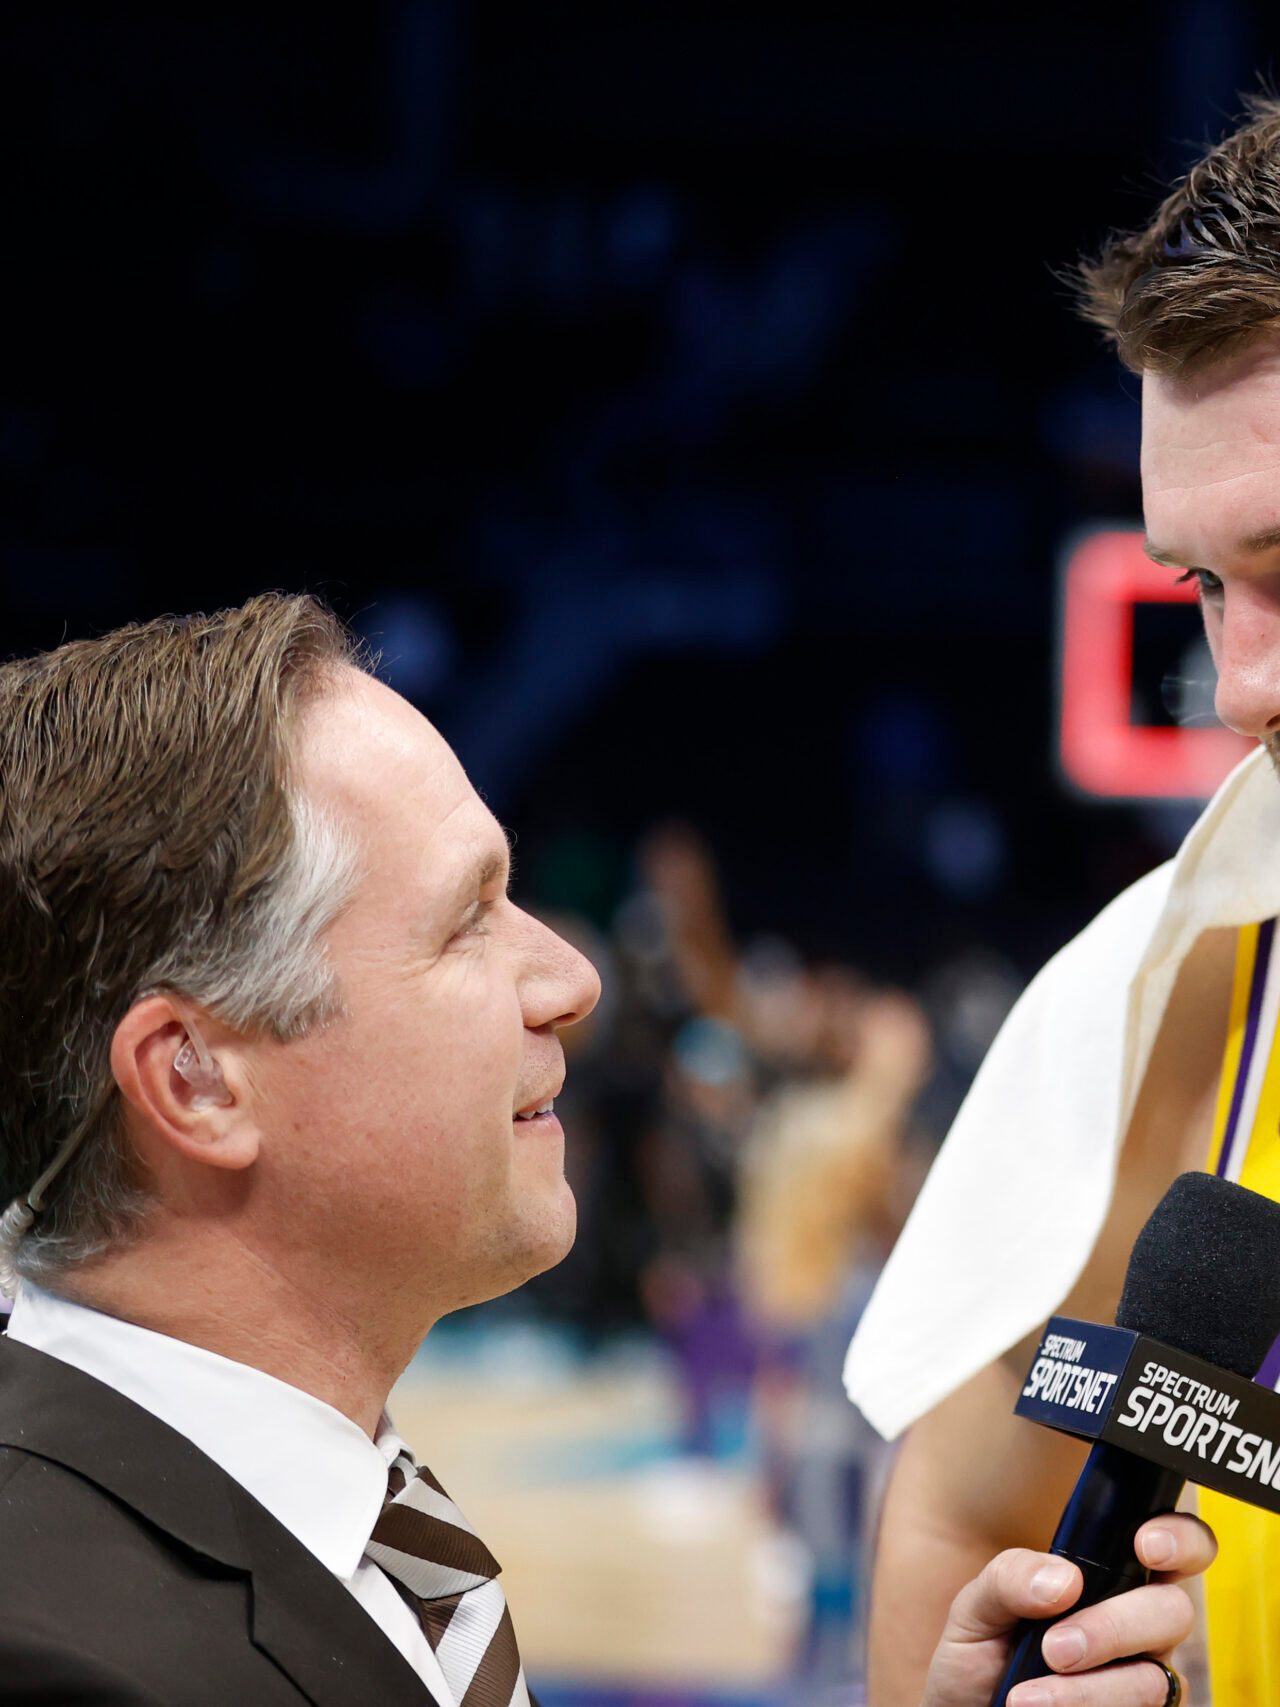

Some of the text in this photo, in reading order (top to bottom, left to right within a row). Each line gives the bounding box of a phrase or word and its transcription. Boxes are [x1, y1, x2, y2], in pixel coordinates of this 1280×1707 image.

[1040, 1334, 1087, 1363] SPECTRUM
[1022, 1358, 1118, 1415] SPORTSNET
[1138, 1361, 1240, 1420] SPECTRUM
